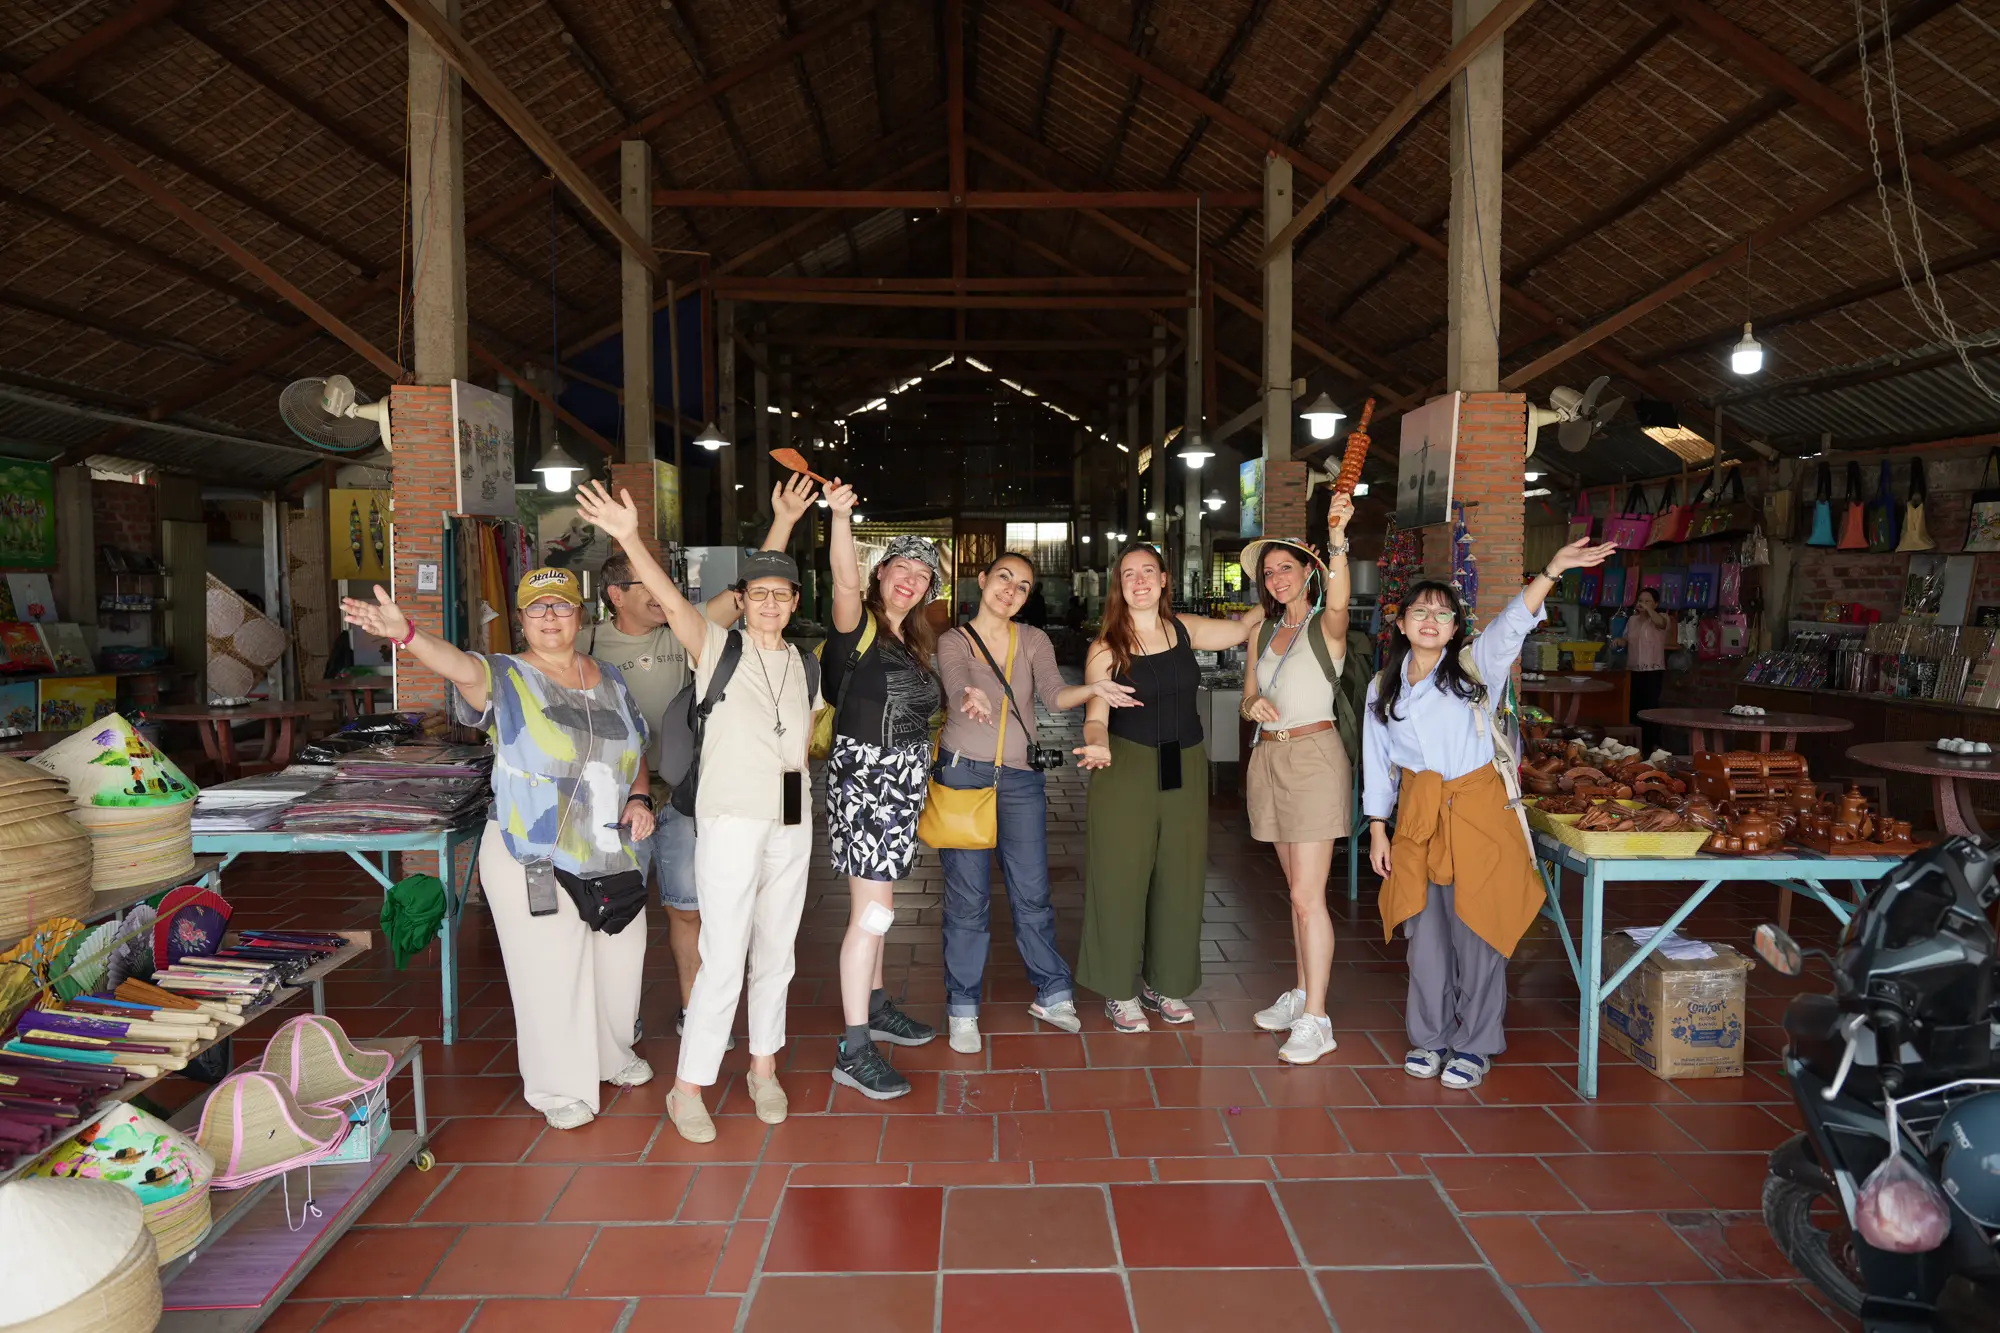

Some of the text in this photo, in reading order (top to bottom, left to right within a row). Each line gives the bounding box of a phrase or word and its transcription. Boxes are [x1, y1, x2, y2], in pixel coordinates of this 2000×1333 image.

[529, 570, 566, 585] Italia
[656, 654, 684, 663] STATES
[1687, 1000, 1727, 1015] Comfort
